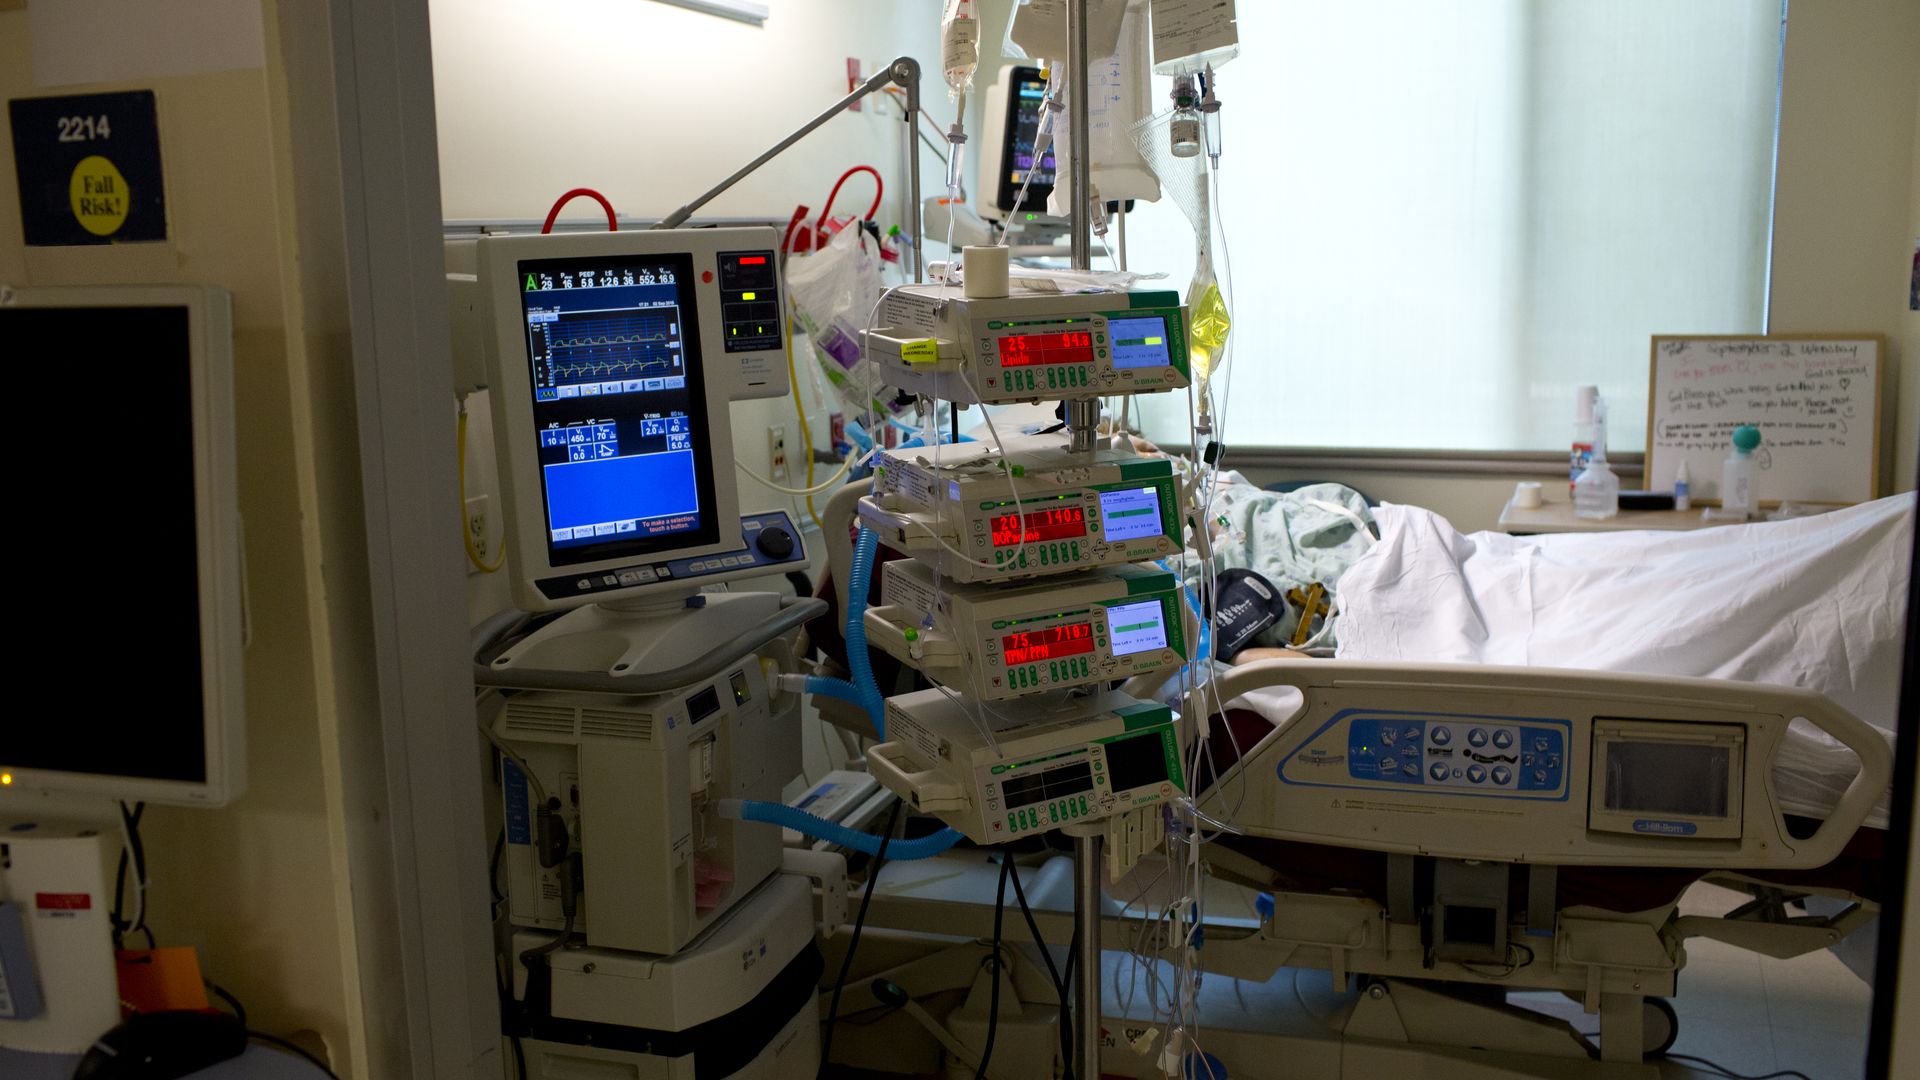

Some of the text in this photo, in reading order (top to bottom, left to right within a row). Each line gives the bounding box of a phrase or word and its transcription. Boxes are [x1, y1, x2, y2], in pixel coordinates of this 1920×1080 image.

[57, 115, 112, 142] 2214
[83, 175, 115, 195] Fall
[80, 196, 123, 217] Risk!
[525, 273, 538, 291] A
[562, 279, 573, 289] 16
[623, 276, 634, 286] 36
[639, 275, 656, 285] 552
[541, 280, 553, 291] 29
[1000, 352, 1030, 366] Lipids
[645, 427, 657, 435] 2.0
[670, 425, 680, 433] 40
[570, 434, 585, 443] 450
[596, 432, 607, 440] 70
[547, 437, 557, 446] 10
[671, 441, 682, 449] 5.0
[573, 452, 585, 460] 0.0
[1046, 508, 1081, 525] 140.6
[641, 520, 650, 528] To
[650, 519, 665, 527] make
[649, 525, 665, 533] touch
[1055, 626, 1089, 642] 718.7
[1005, 645, 1049, 664] TPN/PPN
